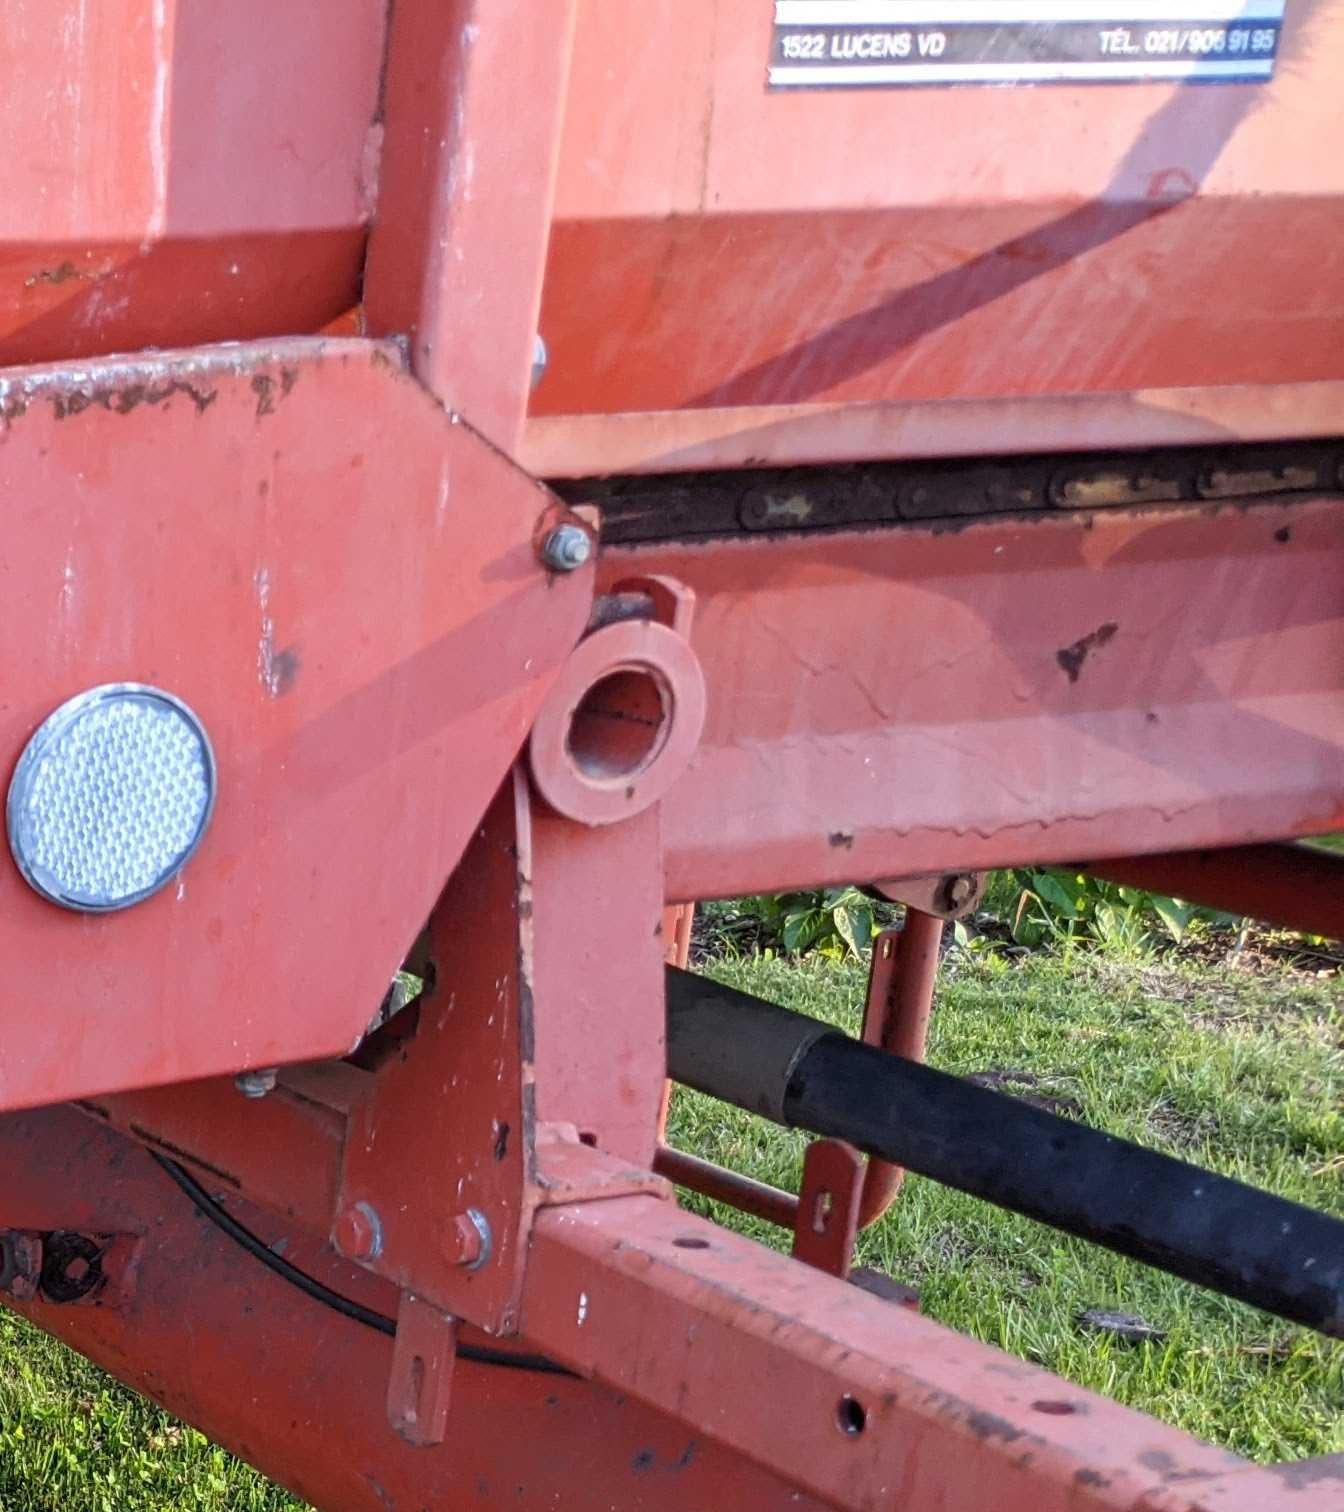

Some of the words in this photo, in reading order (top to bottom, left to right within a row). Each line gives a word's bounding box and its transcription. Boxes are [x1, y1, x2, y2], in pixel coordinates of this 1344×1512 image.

[782, 34, 825, 58] 1522
[830, 33, 911, 59] LUCENS
[917, 32, 946, 57] VD
